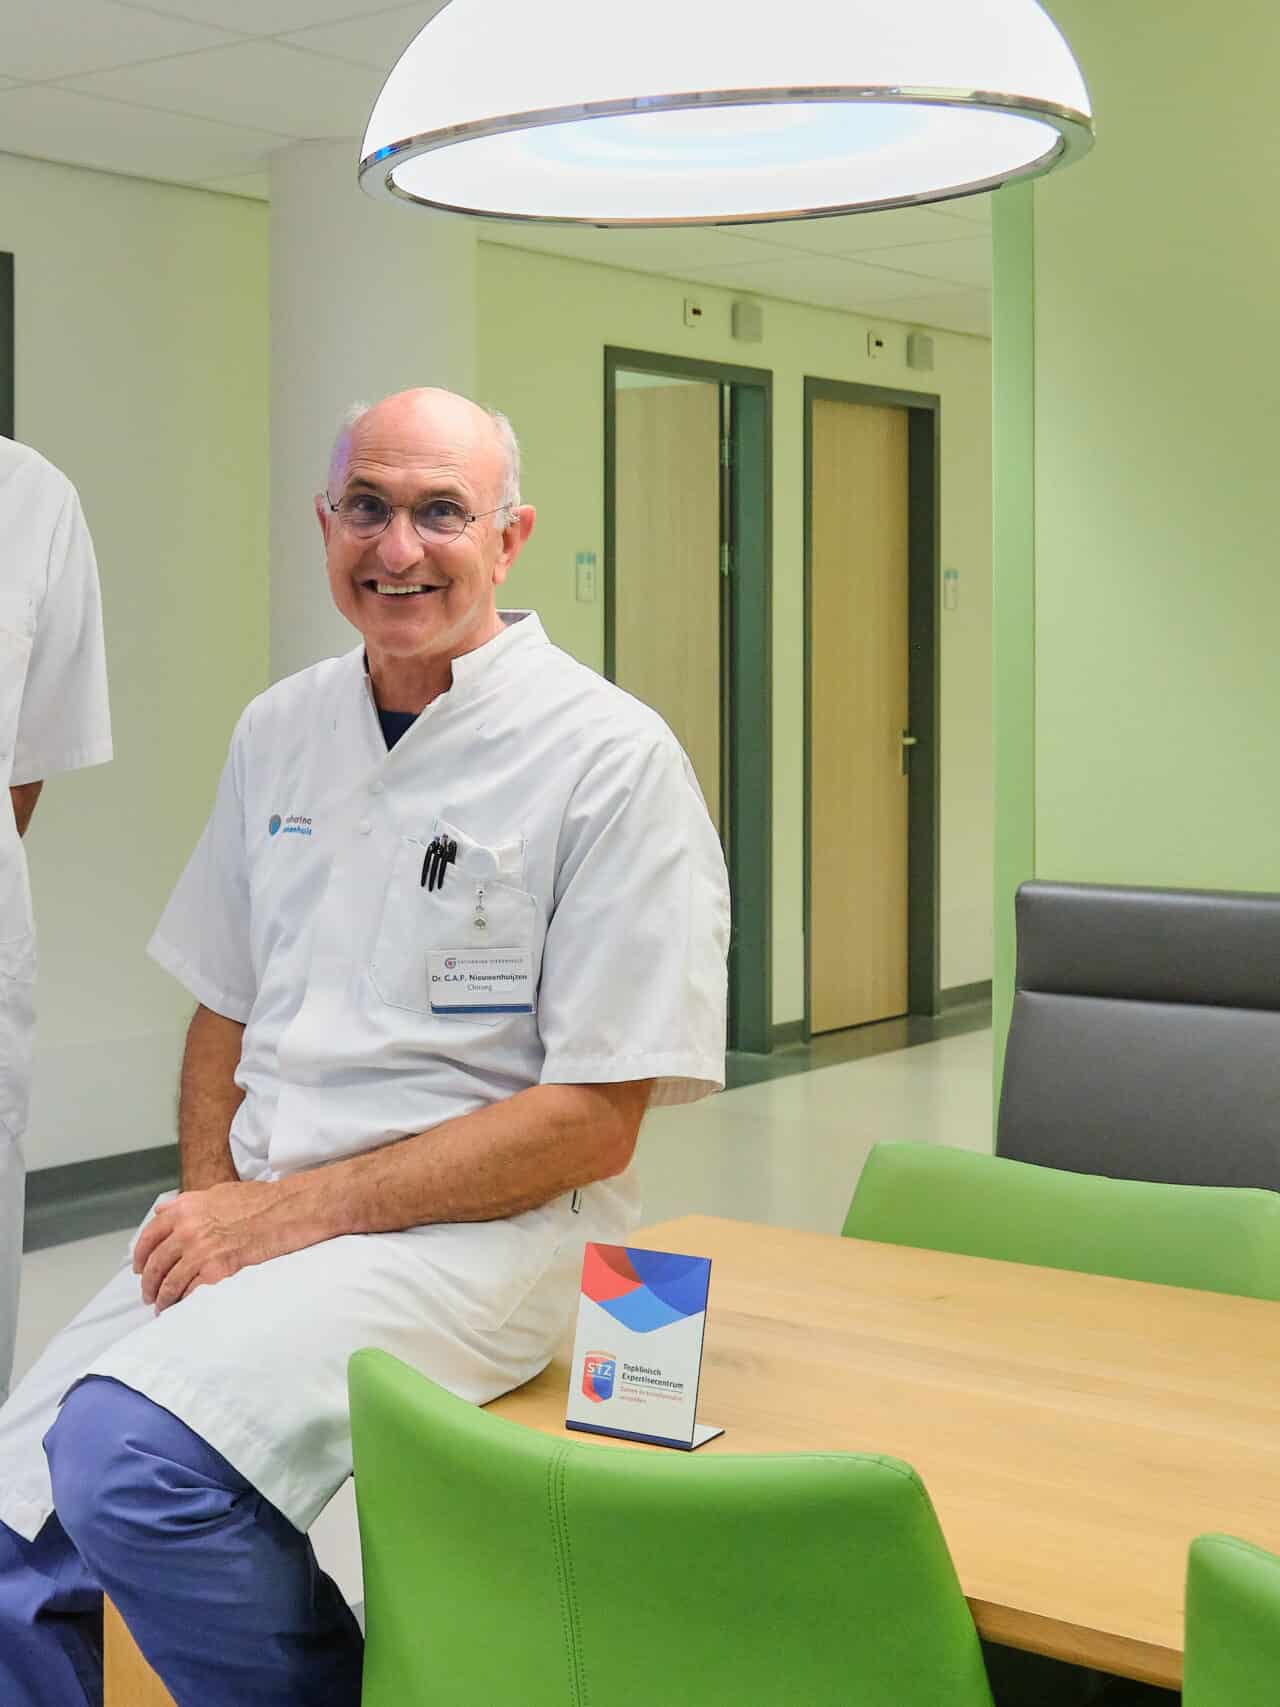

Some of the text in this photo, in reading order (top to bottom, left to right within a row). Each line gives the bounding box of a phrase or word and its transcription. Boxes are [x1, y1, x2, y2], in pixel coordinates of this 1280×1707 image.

[587, 1361, 613, 1377] STZ
[623, 1363, 662, 1377] Topklinisch
[621, 1372, 685, 1390] Expertisecentrum
